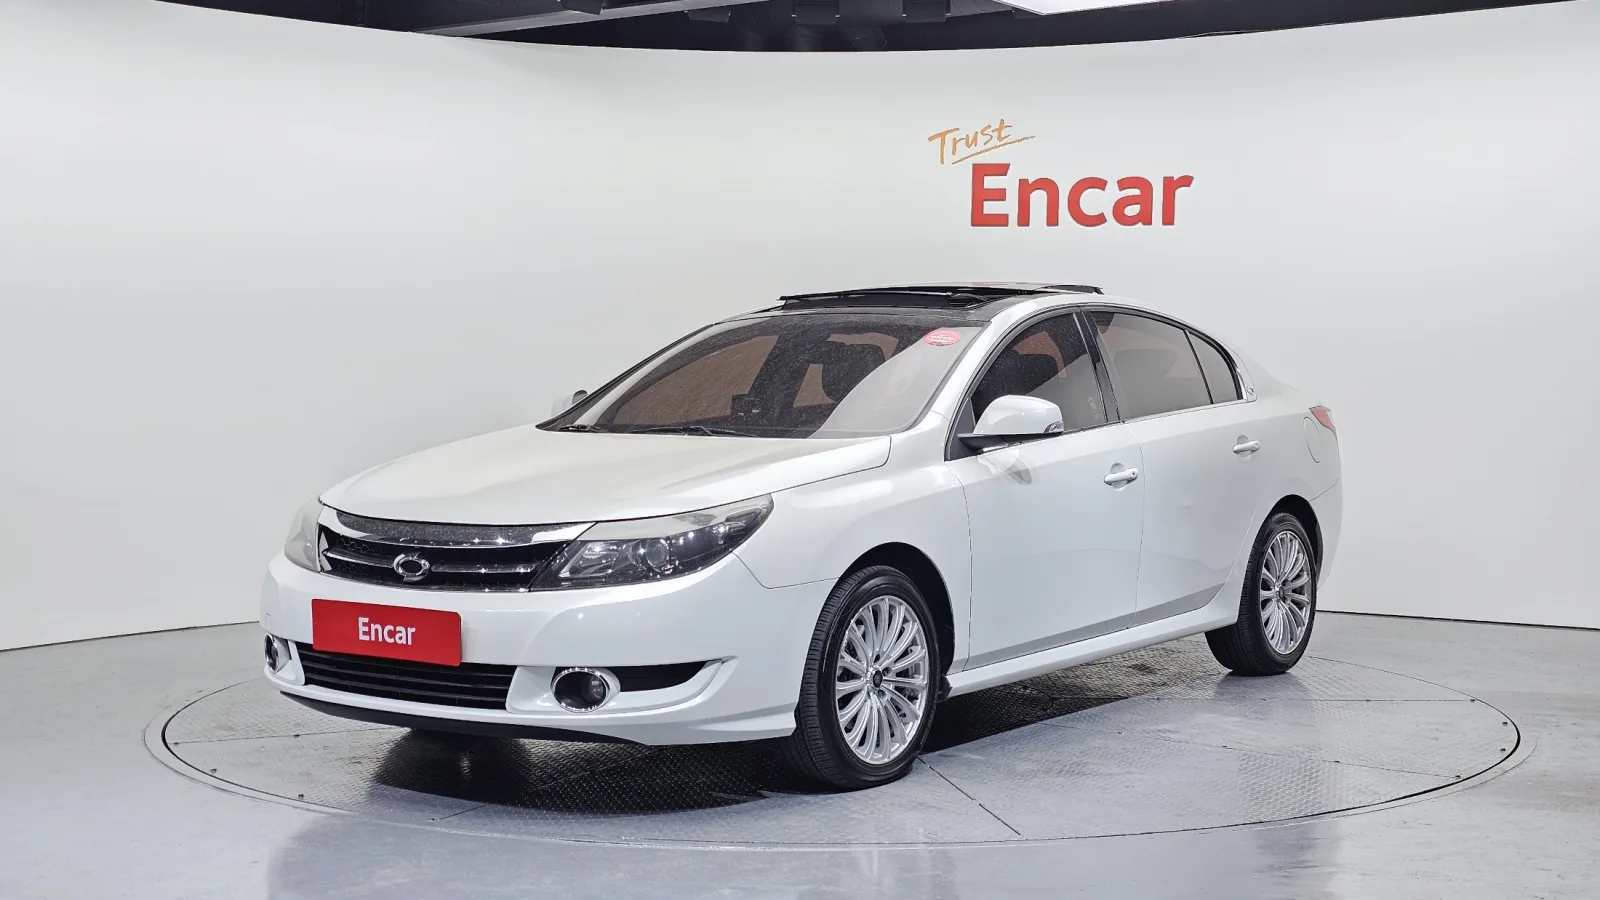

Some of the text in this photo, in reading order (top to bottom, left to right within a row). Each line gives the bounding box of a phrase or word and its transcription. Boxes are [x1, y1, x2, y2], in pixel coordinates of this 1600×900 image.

[928, 119, 1013, 164] Trust
[970, 163, 1194, 227] Encar
[358, 616, 416, 645] Encar
